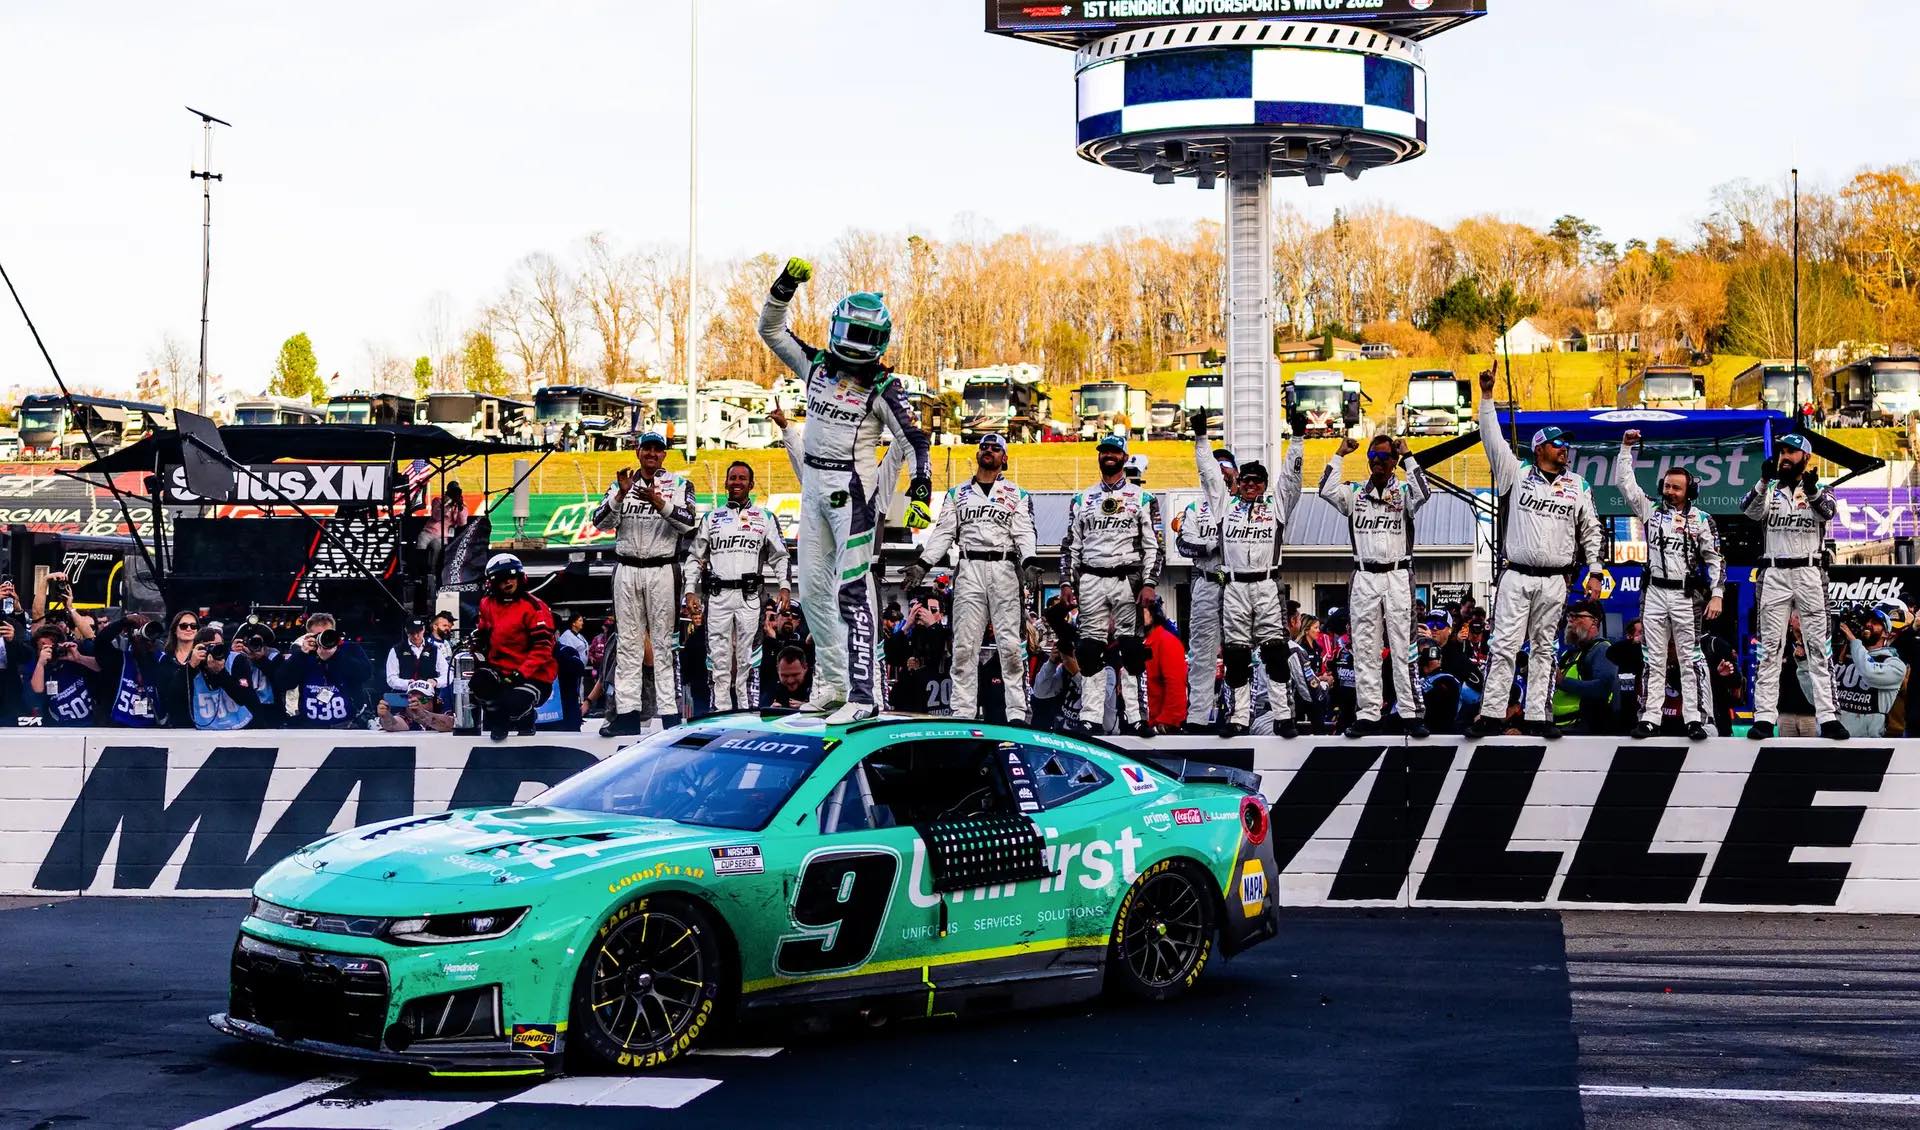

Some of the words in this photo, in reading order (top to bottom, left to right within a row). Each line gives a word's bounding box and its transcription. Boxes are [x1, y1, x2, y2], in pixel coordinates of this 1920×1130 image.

[1083, 1, 1105, 17] 1ST
[1109, 0, 1181, 17] HENDRICK
[1182, 0, 1290, 15] MOTORSPORTS
[1294, 0, 1317, 11] WIN
[1327, 0, 1341, 9] OF
[1567, 446, 1750, 488] niirst
[170, 464, 386, 501] SiusXM
[1519, 492, 1574, 516] UniFirst
[1691, 496, 1742, 506] OLUTION
[959, 505, 1012, 523] UniFirst
[709, 535, 762, 551] UniFirst
[1225, 525, 1273, 539] UniFirst
[62, 552, 89, 584] 77
[89, 554, 113, 562] HOCEVAR
[1827, 576, 1904, 600] ndrick
[852, 605, 870, 682] UniFirst
[306, 696, 347, 721] 538
[889, 731, 924, 739] CHASE
[925, 729, 969, 737] ELLIOTT
[719, 738, 809, 755] ELLIOTT
[1143, 811, 1171, 827] prime
[721, 859, 734, 868] CUP
[734, 858, 757, 868] SERIES
[727, 847, 754, 856] NASCAR
[607, 862, 705, 894] GOODYEAR
[908, 826, 1143, 908] Uirst
[1243, 873, 1264, 901] NAPA
[600, 898, 650, 938] EAGLE
[772, 843, 902, 977] 9
[973, 914, 1022, 930] SERVICES
[1037, 905, 1104, 922] SOLUTIONS
[443, 963, 480, 973] Hendrick
[1185, 939, 1211, 988] EAGLE
[513, 1033, 554, 1043] SUNOCO
[617, 1000, 713, 1067] GOODYEAR
